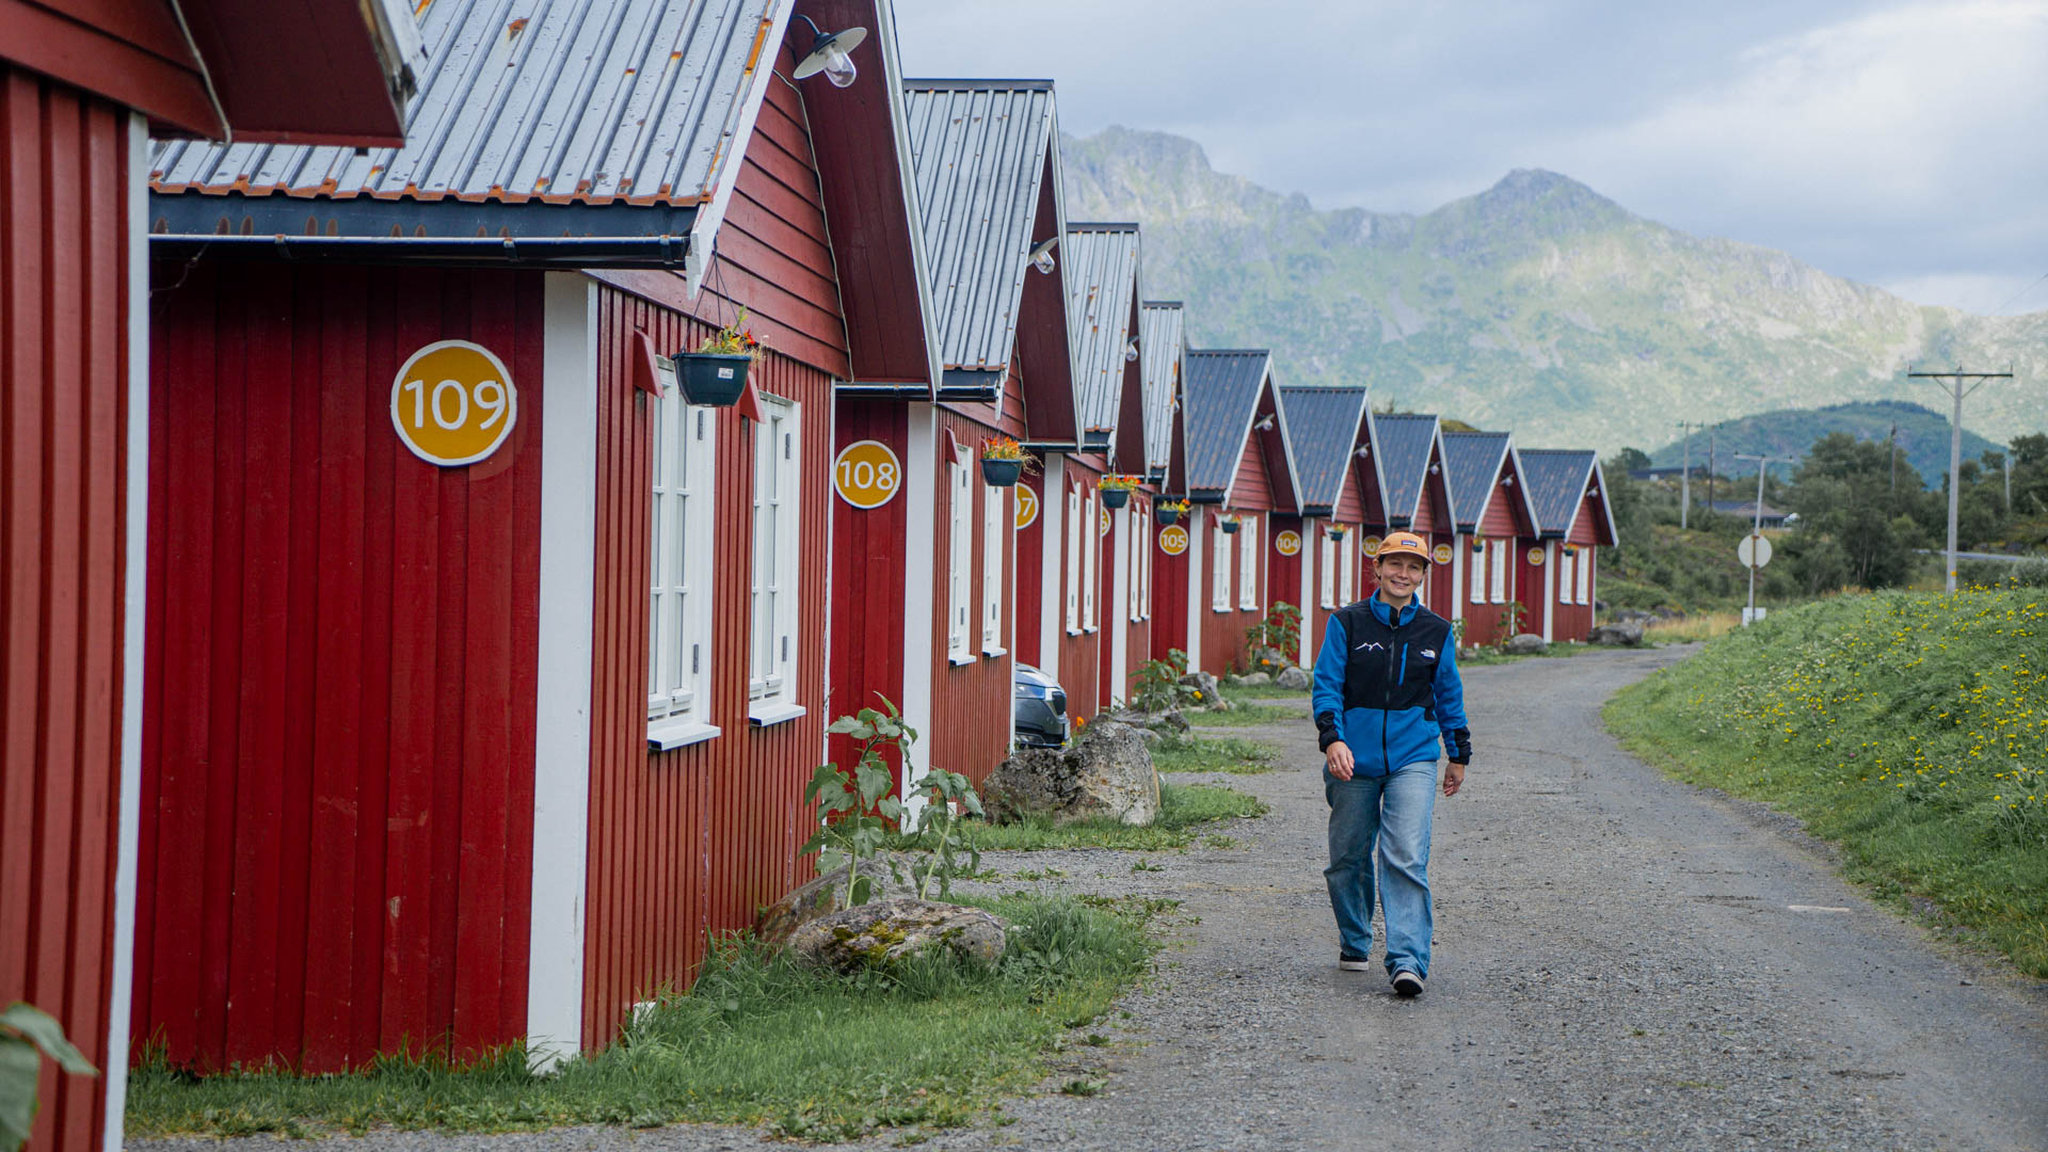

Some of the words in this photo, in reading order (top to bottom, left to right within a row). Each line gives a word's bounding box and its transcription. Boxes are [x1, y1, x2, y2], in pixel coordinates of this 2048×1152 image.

[404, 379, 506, 430] 109
[840, 460, 894, 490] 108
[1162, 534, 1185, 547] 105
[1279, 538, 1298, 549] 104
